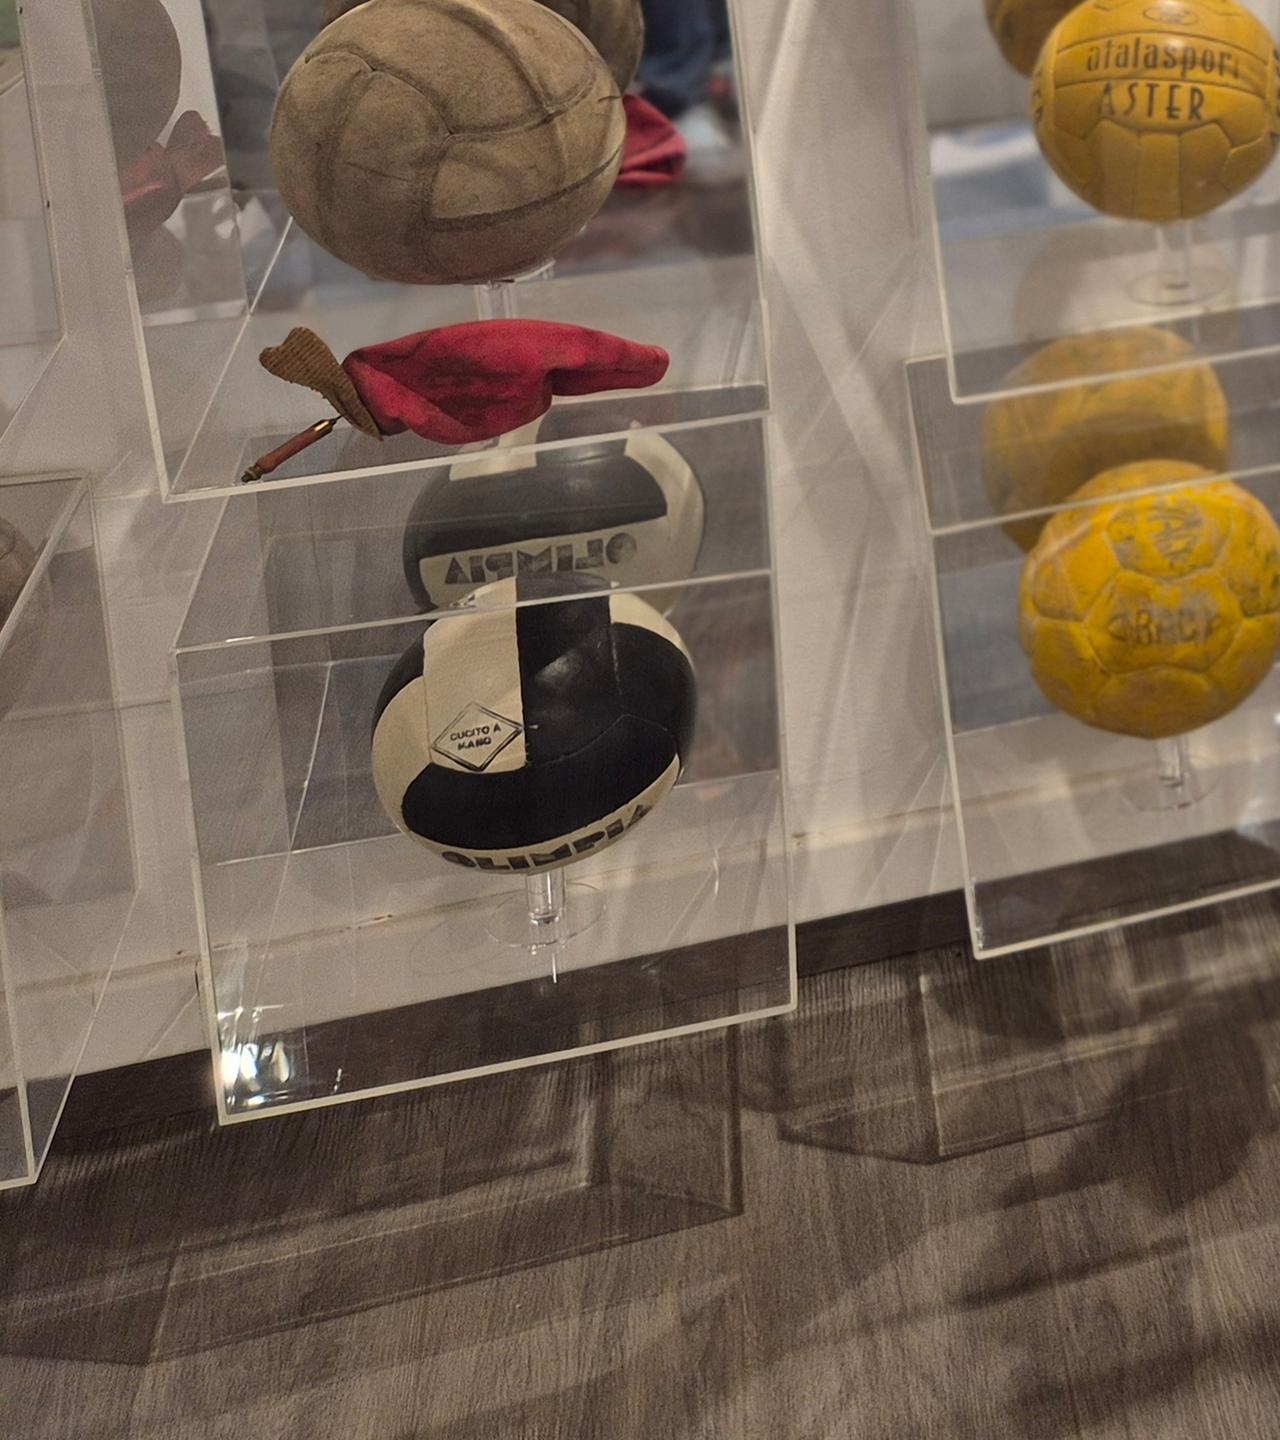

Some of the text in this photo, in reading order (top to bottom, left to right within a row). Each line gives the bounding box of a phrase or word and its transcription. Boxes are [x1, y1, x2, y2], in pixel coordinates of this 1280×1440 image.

[1100, 81, 1206, 122] ASTER
[450, 723, 502, 742] CUCITO A
[457, 736, 492, 750] MANO
[441, 804, 653, 870] OLIMPIA
